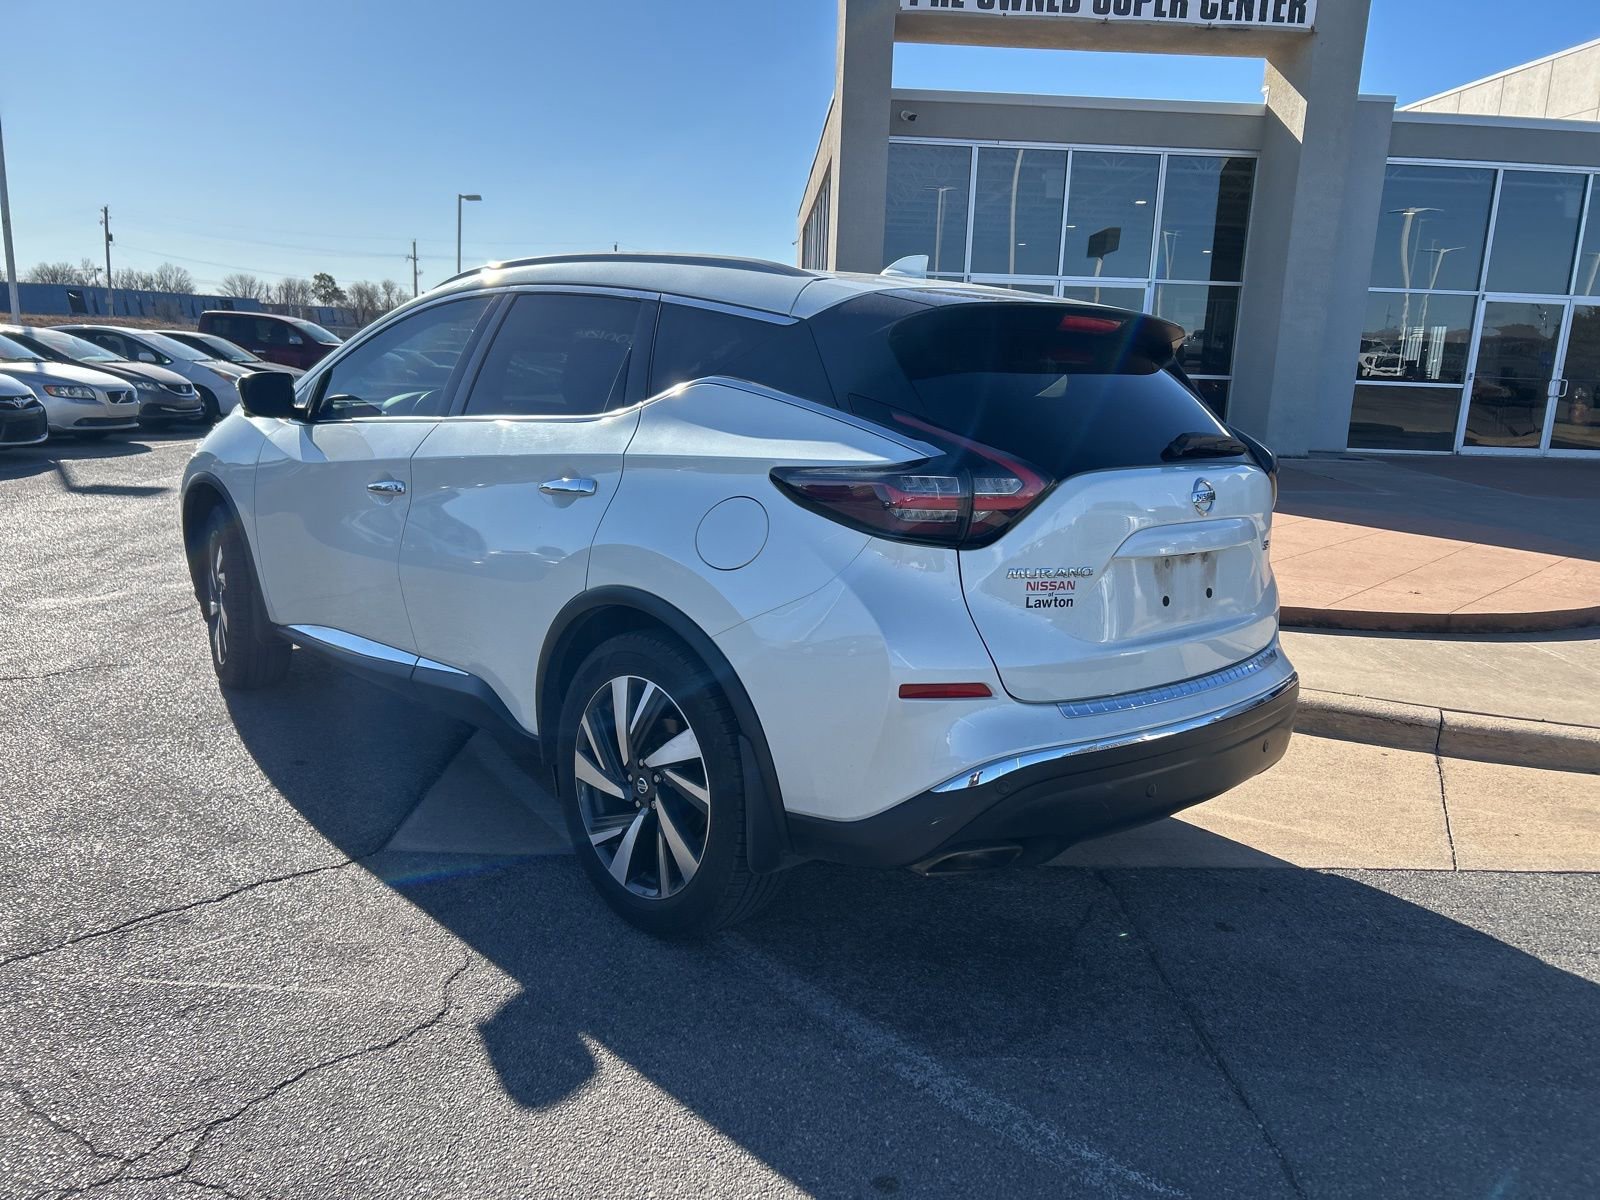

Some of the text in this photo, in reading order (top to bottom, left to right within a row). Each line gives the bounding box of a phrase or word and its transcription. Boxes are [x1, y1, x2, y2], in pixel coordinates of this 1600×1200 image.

[1007, 566, 1094, 579] MURANO
[1026, 581, 1076, 591] NISSAN
[1025, 597, 1074, 609] Lawton
